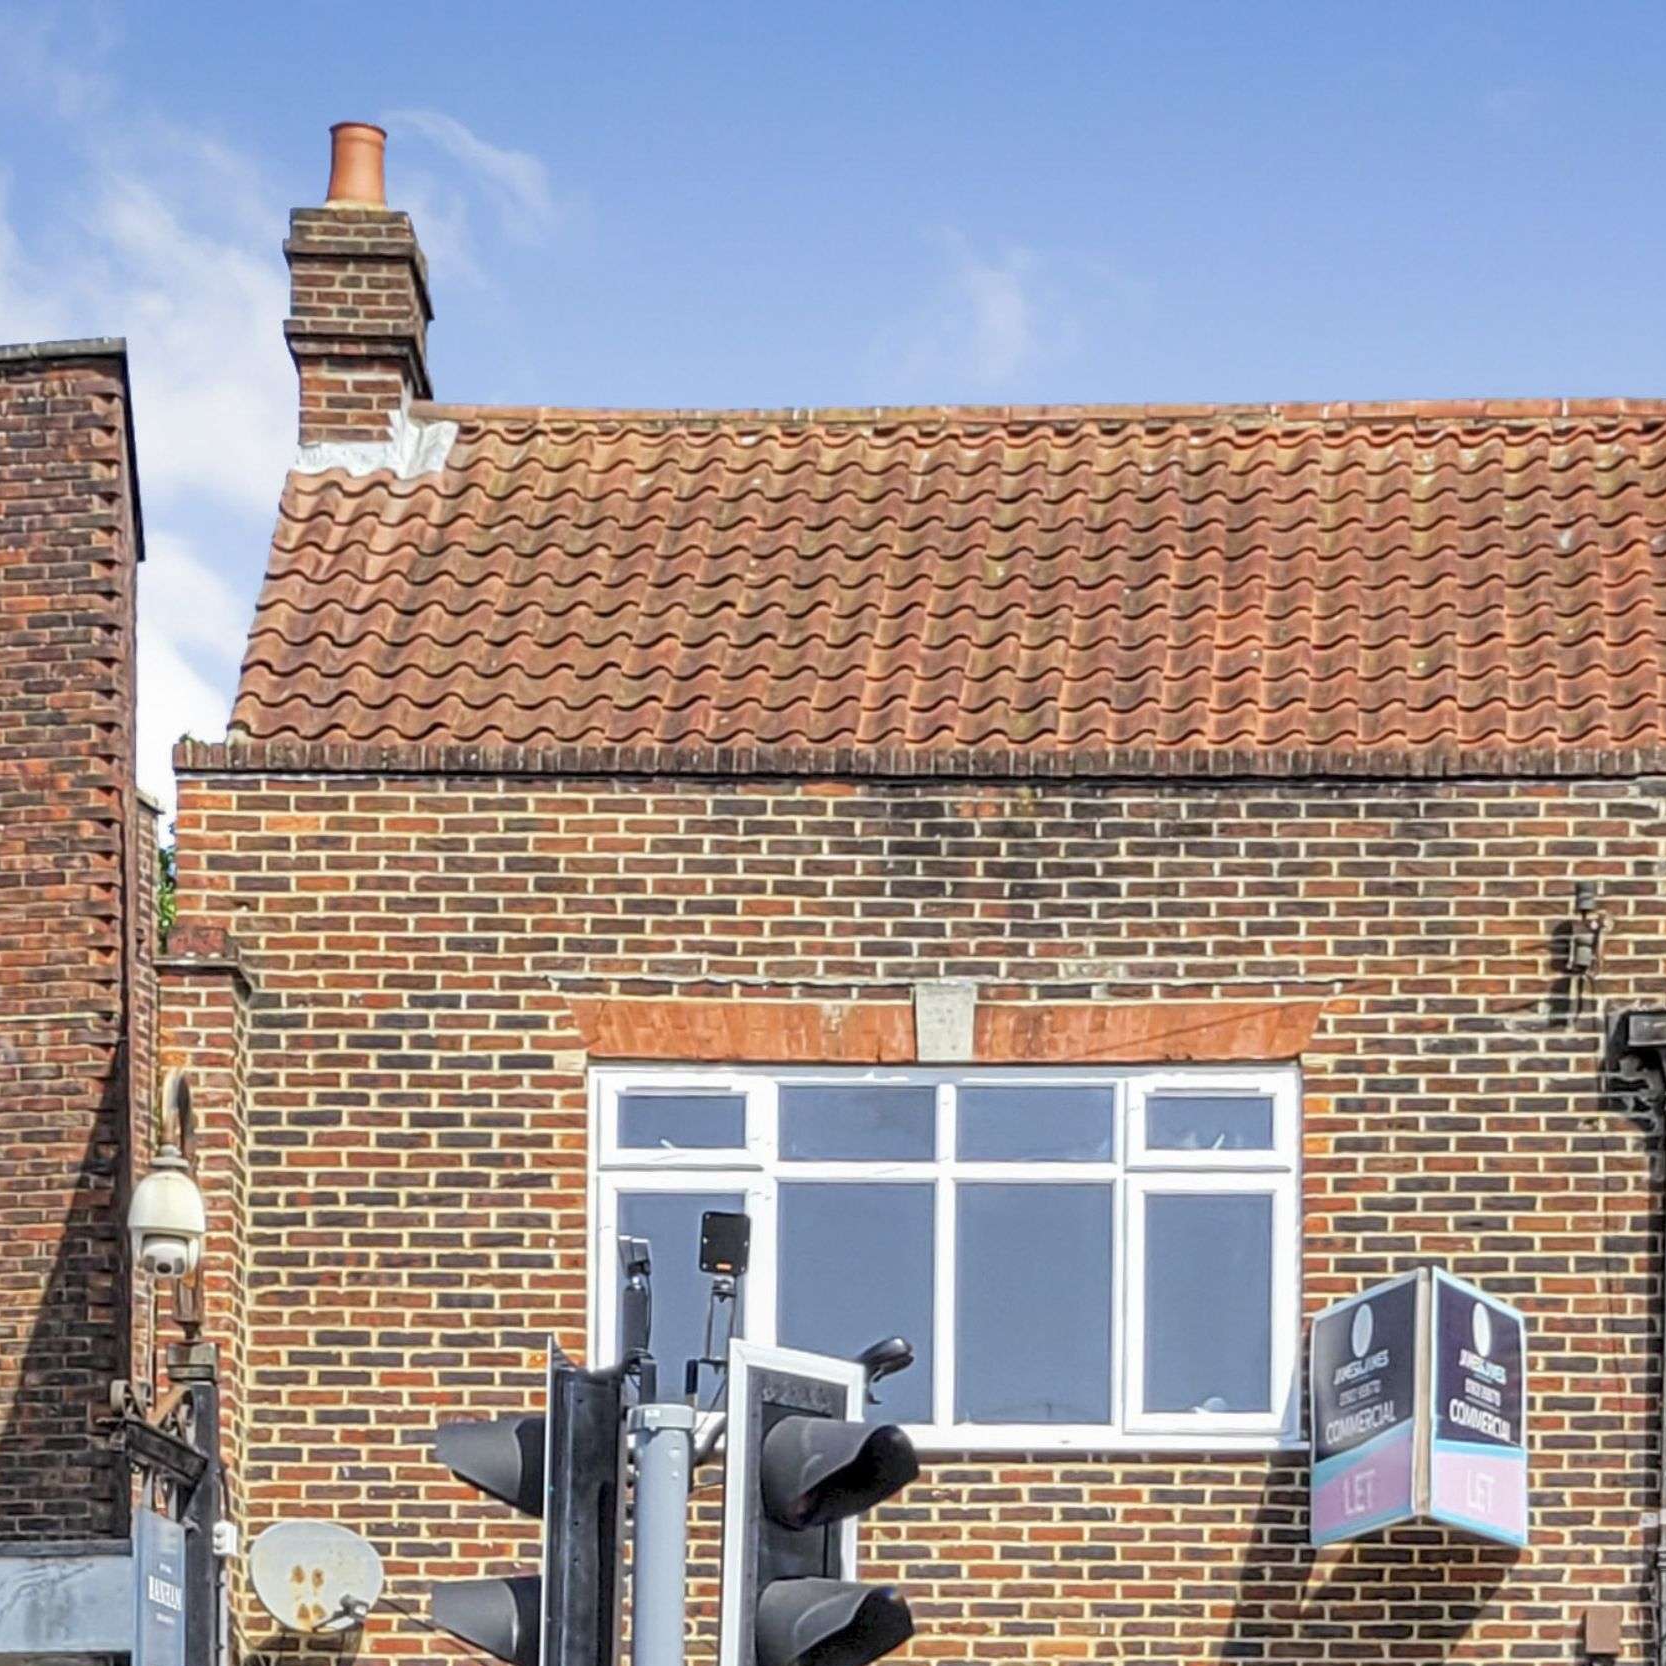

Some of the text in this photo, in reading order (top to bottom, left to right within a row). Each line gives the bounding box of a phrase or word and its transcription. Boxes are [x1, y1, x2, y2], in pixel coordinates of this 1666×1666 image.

[1326, 1401, 1397, 1446] COMMERCIAL
[1449, 1398, 1511, 1442] COMMERCIAL
[1342, 1469, 1376, 1515] LET
[1467, 1467, 1495, 1512] LET
